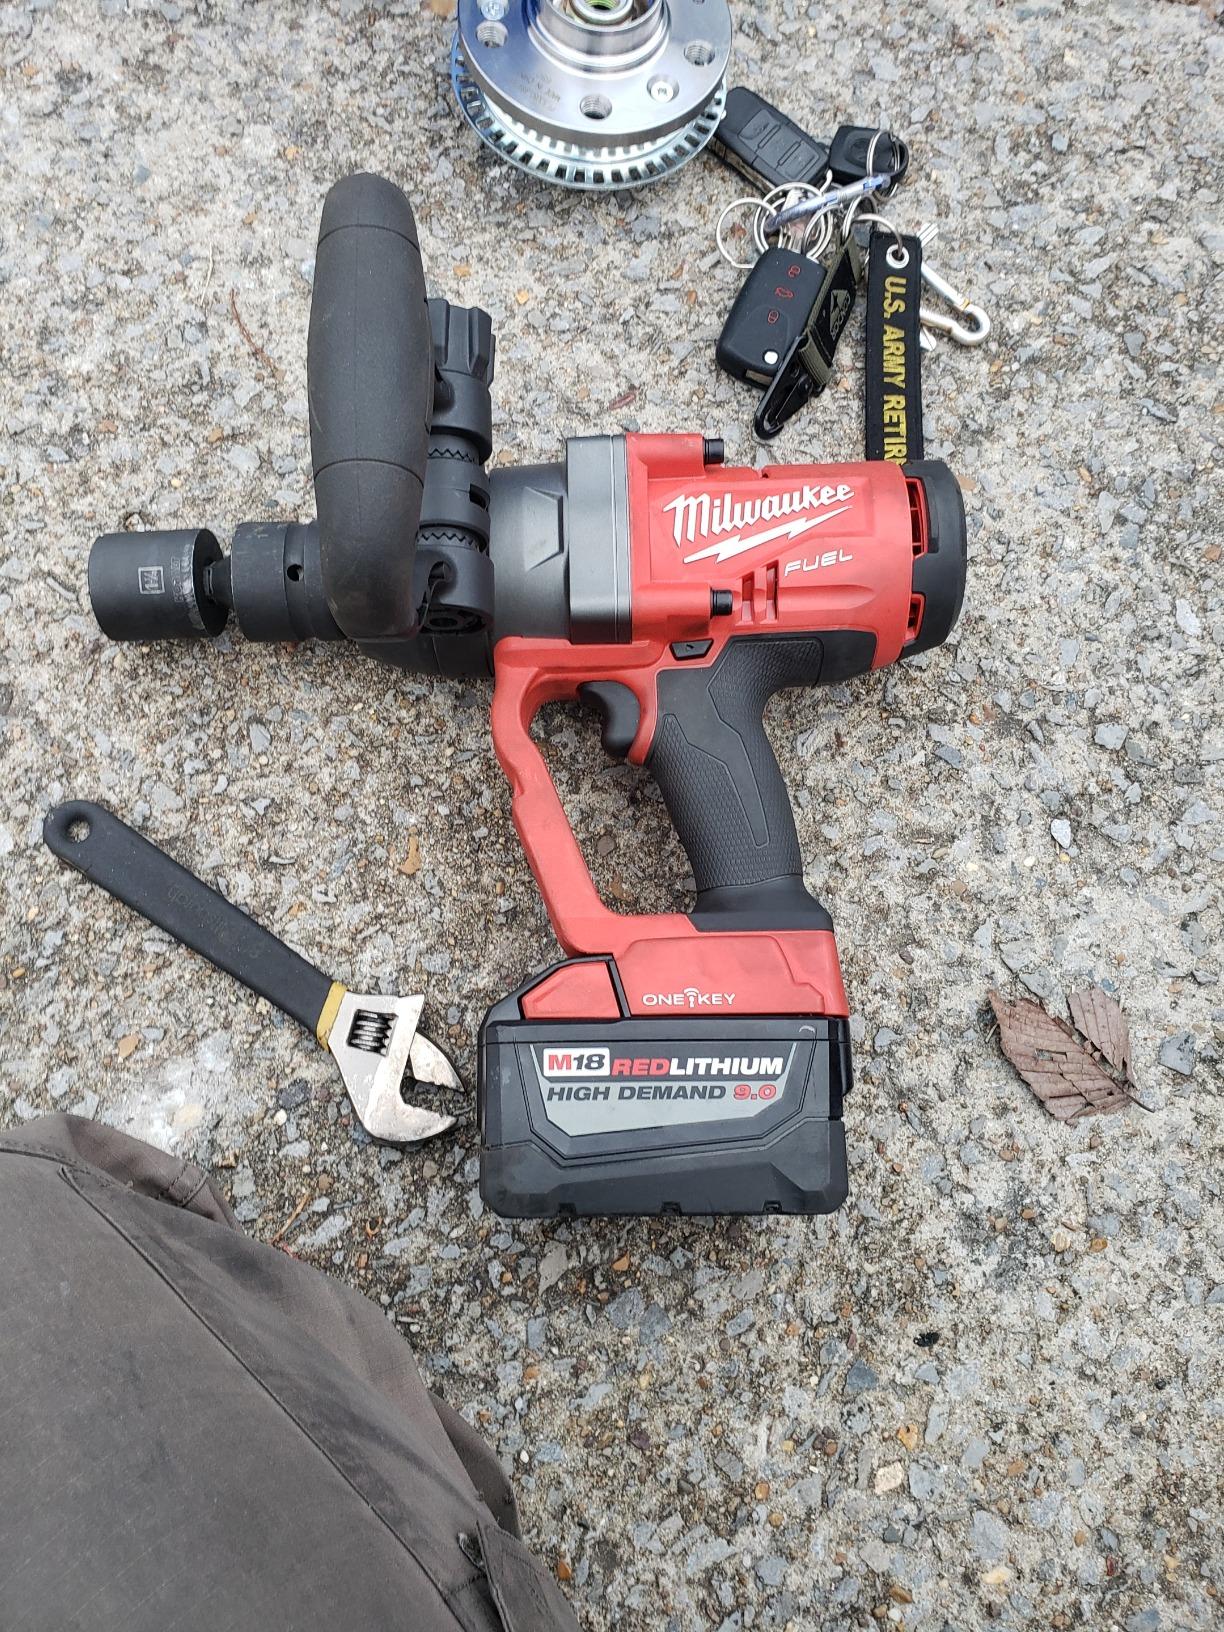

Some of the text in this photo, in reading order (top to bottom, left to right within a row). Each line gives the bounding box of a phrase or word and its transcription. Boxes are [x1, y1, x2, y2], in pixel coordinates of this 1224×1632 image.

[882, 324, 906, 389] ARMY
[662, 484, 855, 549] Milwaukee
[784, 549, 853, 577] FUEL
[548, 1053, 606, 1071] M18
[547, 1084, 777, 1102] HIGH DEMAND 9.0
